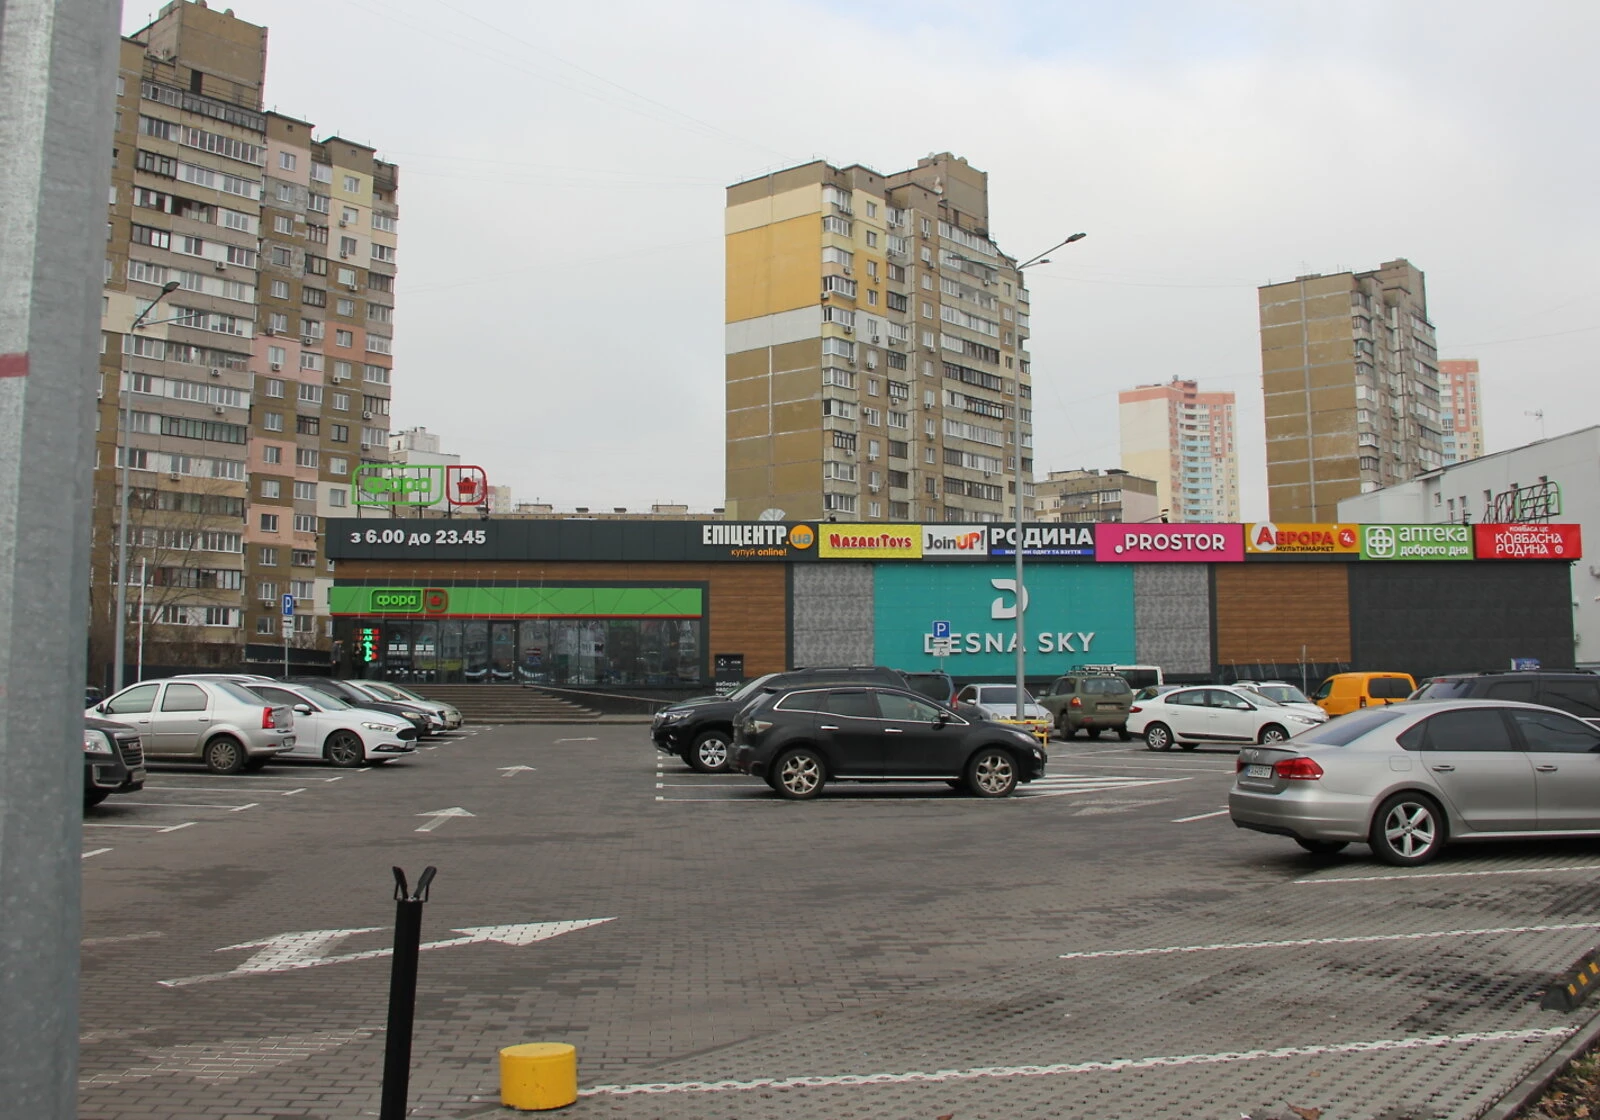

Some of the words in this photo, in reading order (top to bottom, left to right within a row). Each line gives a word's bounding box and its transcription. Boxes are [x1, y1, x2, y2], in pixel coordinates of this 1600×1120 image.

[365, 529, 405, 544] 6.00
[408, 533, 431, 546] до
[435, 530, 487, 544] 23.45
[990, 527, 1094, 548] РОДИНА
[1399, 526, 1468, 542] аптека
[757, 548, 788, 557] online!
[1400, 545, 1446, 557] доброго
[1448, 546, 1468, 556] дня
[1038, 632, 1096, 653] SKY
